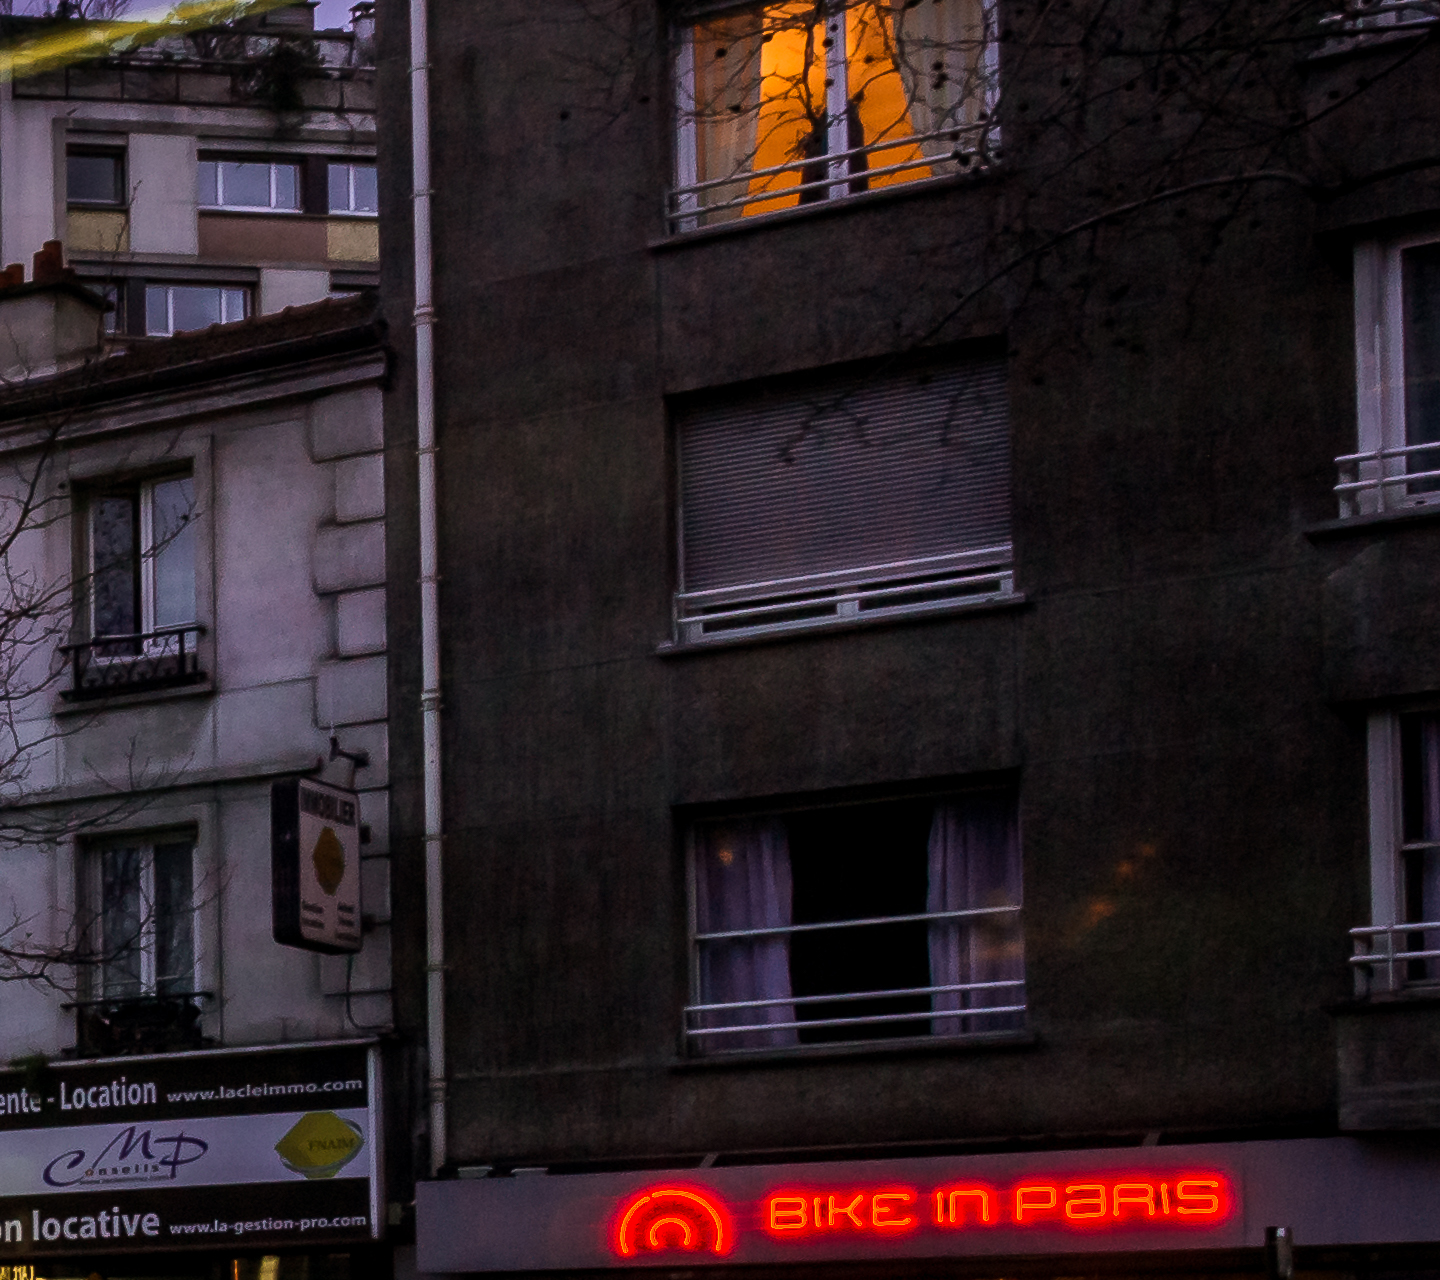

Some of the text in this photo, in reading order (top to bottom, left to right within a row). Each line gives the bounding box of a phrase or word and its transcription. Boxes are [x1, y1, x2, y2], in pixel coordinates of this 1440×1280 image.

[61, 1077, 157, 1110] Location
[167, 1079, 363, 1102] www.lacleimmo.com
[308, 1137, 356, 1151] FNAIM
[32, 1206, 160, 1241] locative
[169, 1214, 367, 1236] www.la-gestion-pro.com
[771, 1193, 911, 1229] BIKE
